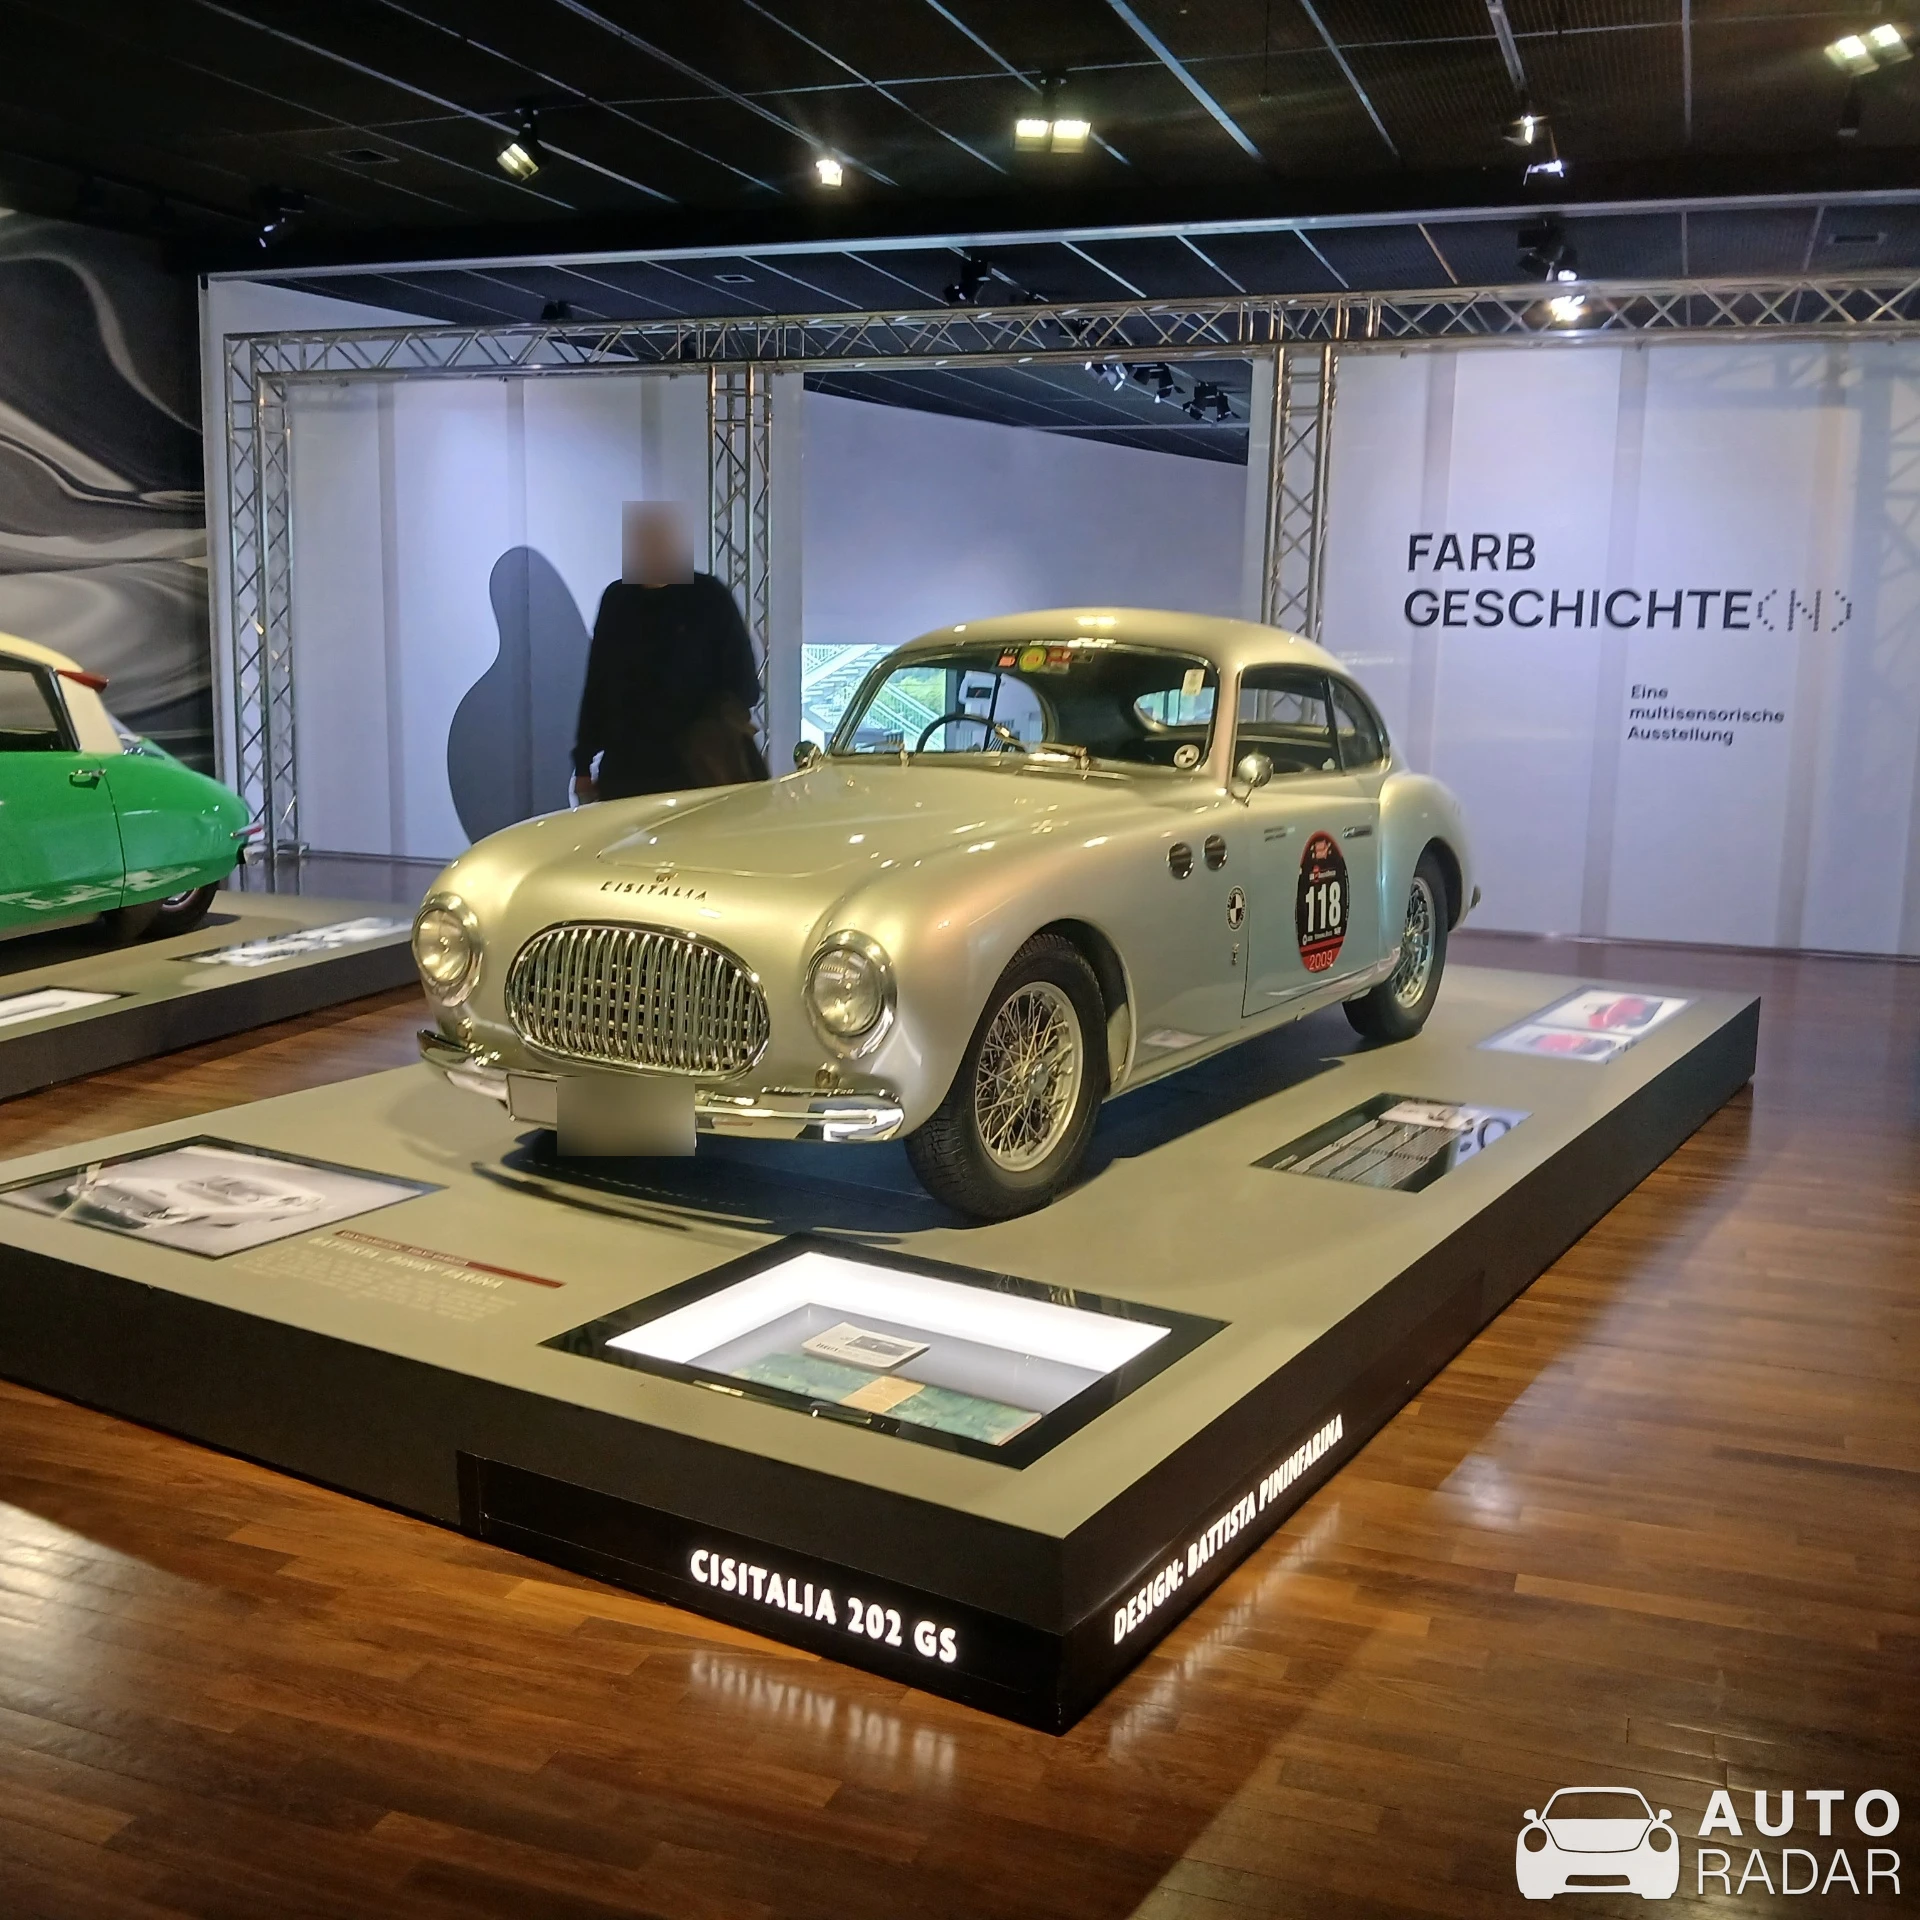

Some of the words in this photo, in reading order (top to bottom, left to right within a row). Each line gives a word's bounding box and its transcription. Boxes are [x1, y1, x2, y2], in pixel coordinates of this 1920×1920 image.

[1407, 533, 1536, 572] FARB
[1403, 588, 1853, 632] GESCHICHTE(N)
[1631, 684, 1669, 700] Eine
[1629, 706, 1785, 723] multisensorische
[1627, 726, 1734, 747] Ausstellung
[600, 881, 707, 901] CISITALIA
[1305, 881, 1341, 933] 118
[1309, 950, 1333, 970] 2009
[1113, 1558, 1184, 1645] DESIGN:
[1187, 1490, 1257, 1578] BATTISTA
[1258, 1413, 1343, 1512] PININFARINA
[690, 1549, 837, 1626] CISITALIA
[847, 1597, 902, 1647] 202
[914, 1620, 957, 1663] GS
